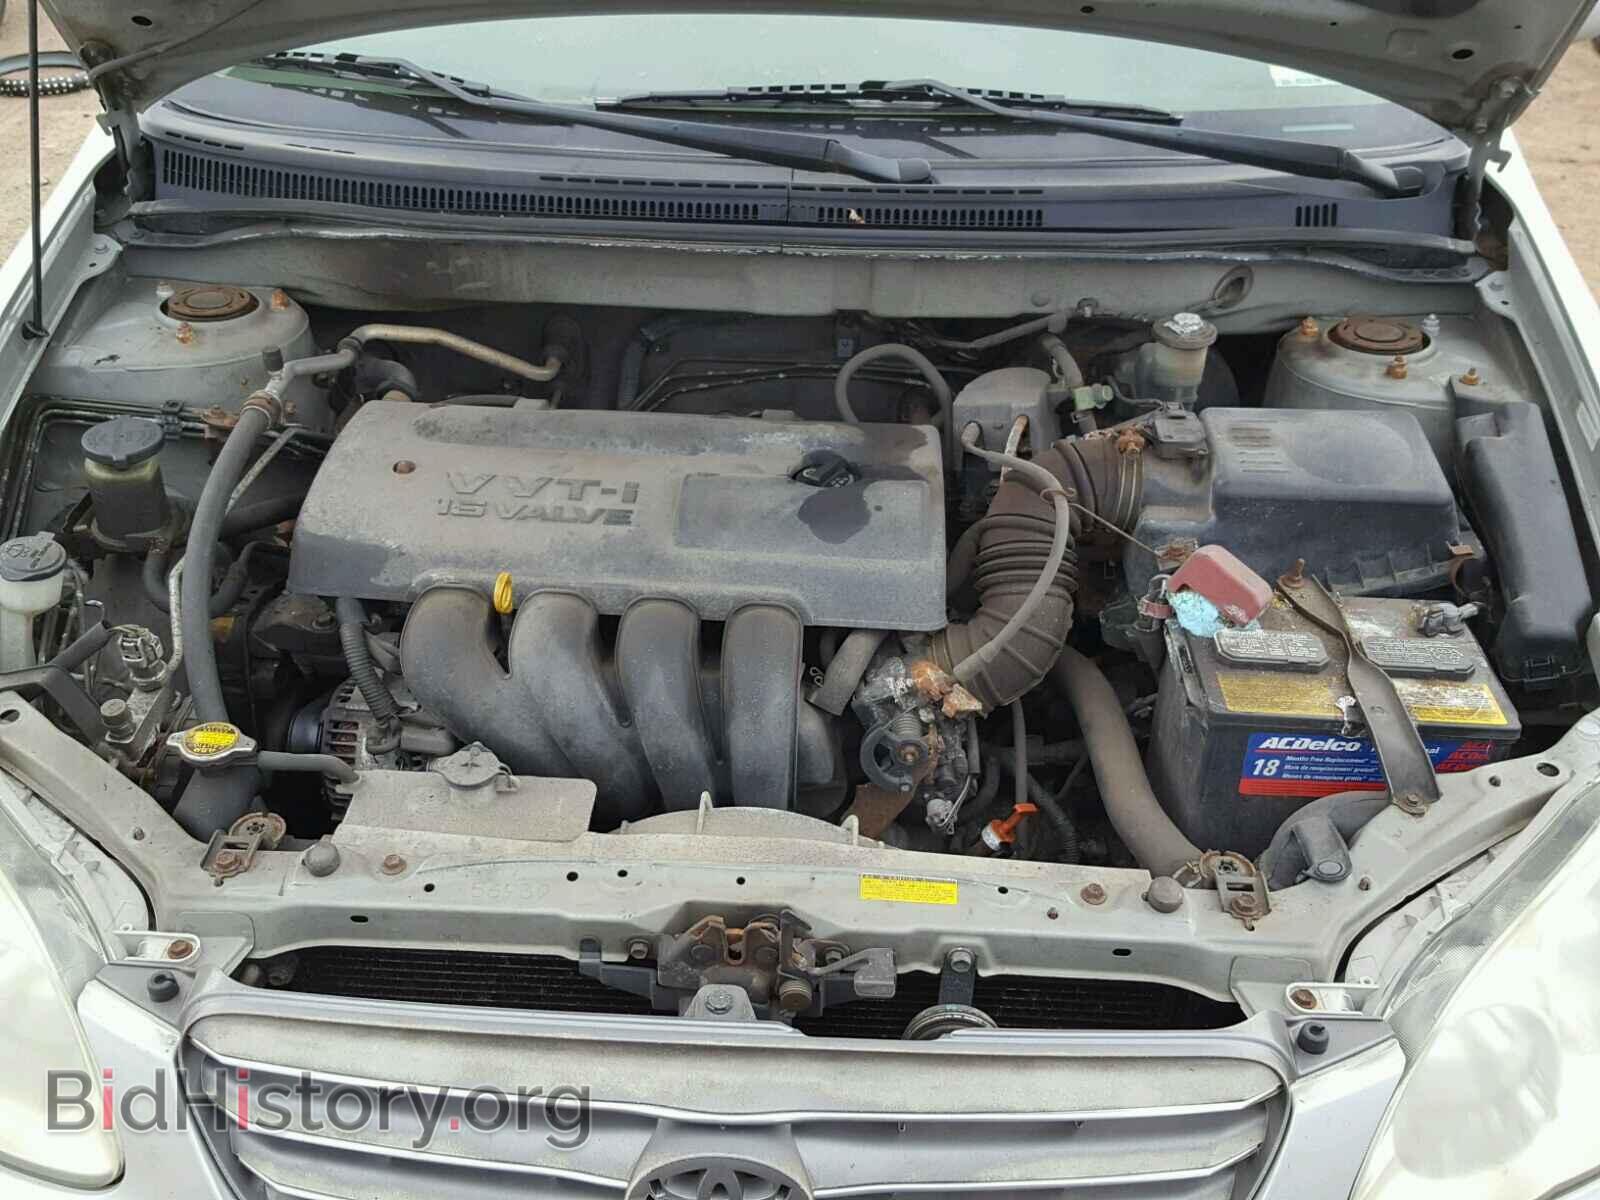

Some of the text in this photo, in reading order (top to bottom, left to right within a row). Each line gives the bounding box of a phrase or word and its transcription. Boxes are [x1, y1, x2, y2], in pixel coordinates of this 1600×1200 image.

[496, 503, 634, 526] VALVE
[1258, 736, 1361, 752] ACDelco
[1252, 758, 1281, 777] 18
